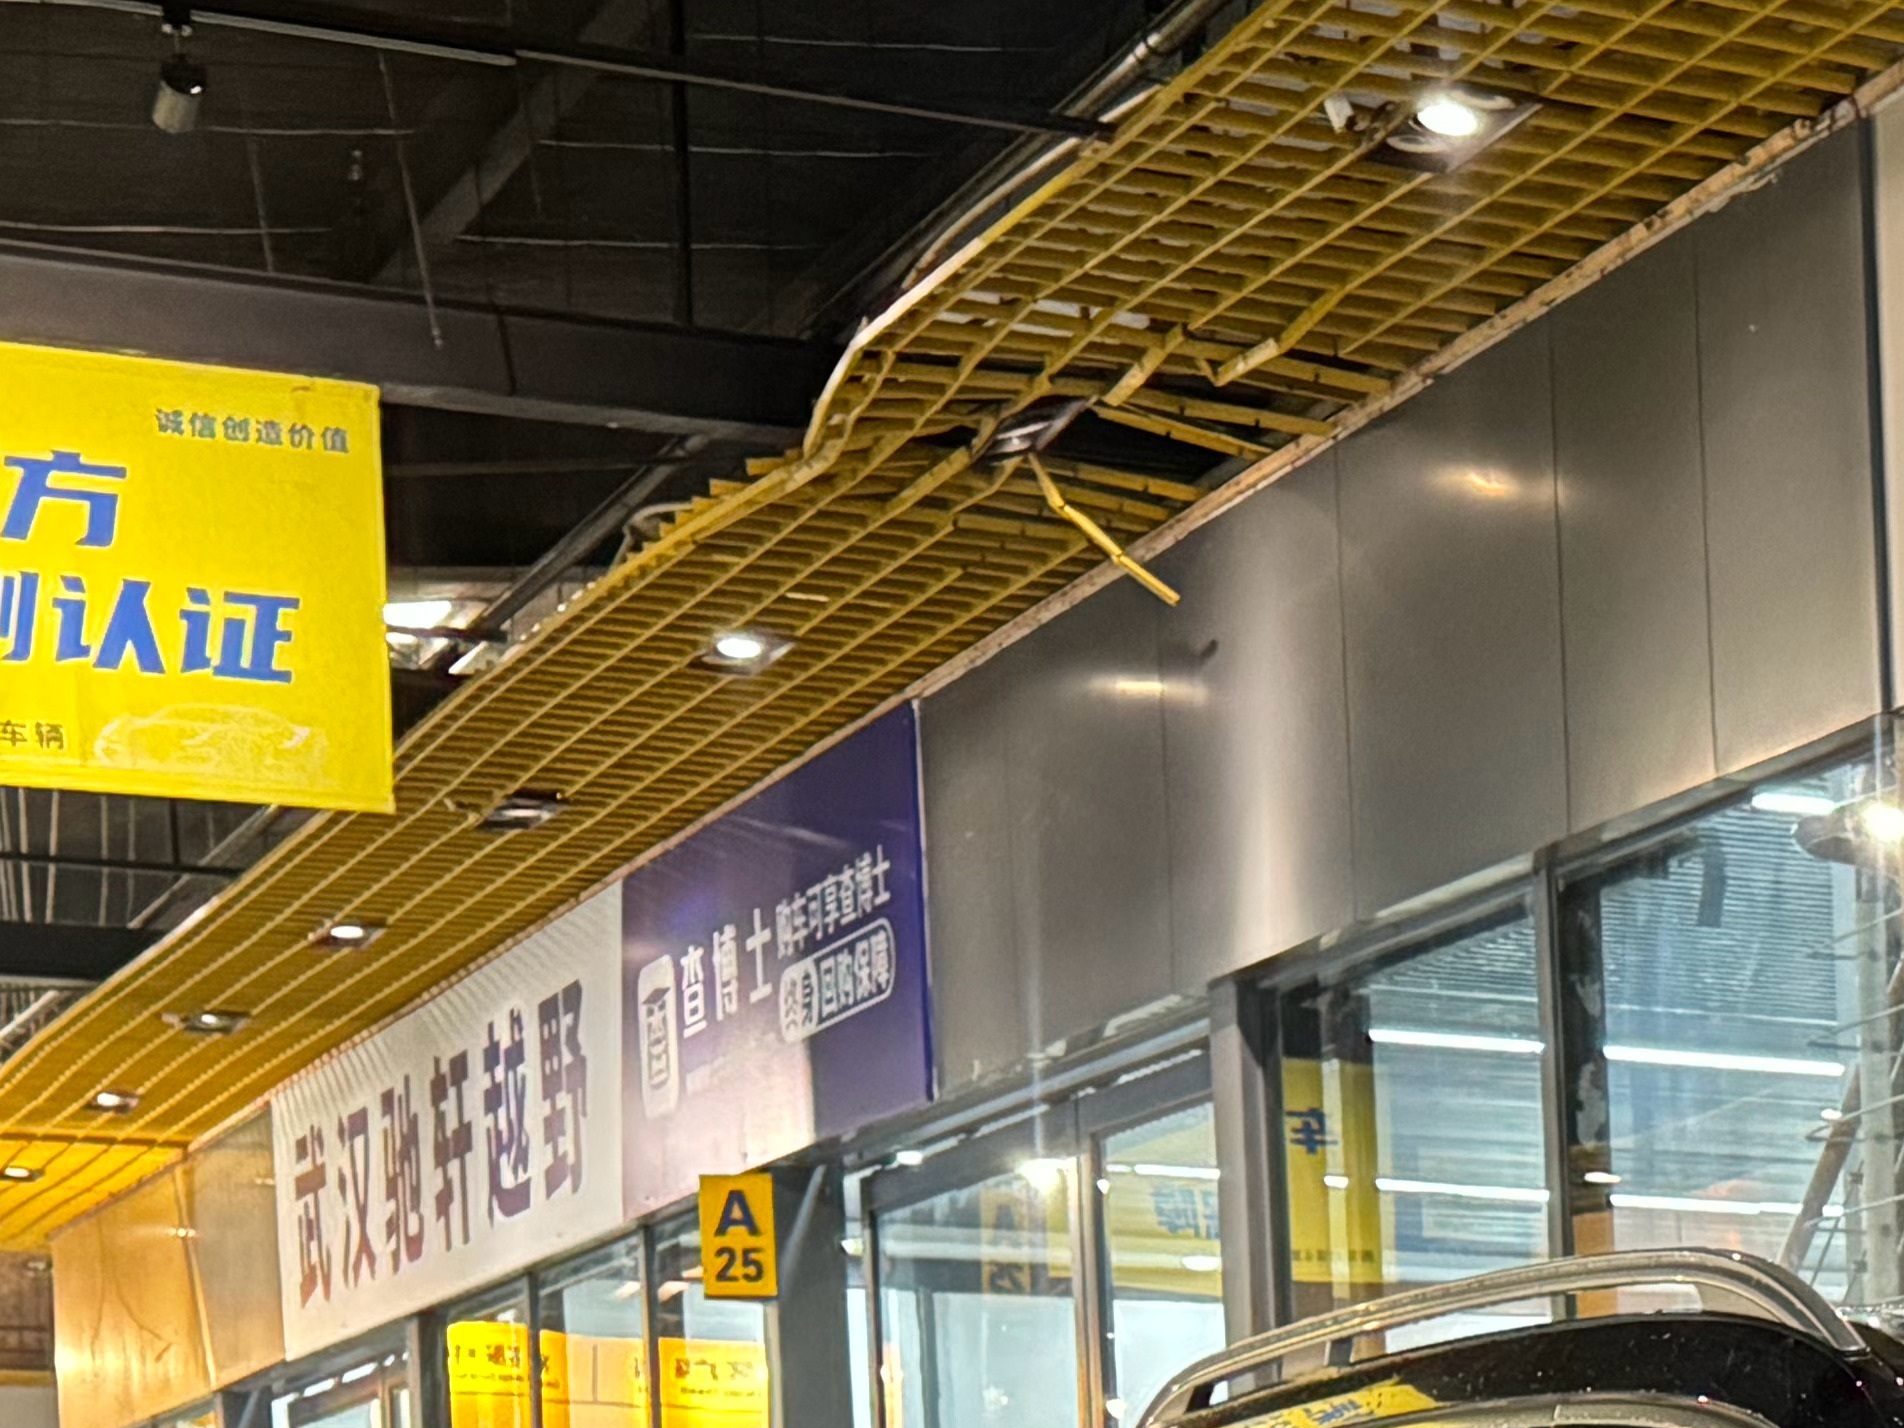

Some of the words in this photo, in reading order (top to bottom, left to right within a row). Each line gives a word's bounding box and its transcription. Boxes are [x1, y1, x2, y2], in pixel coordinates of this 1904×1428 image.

[154, 407, 350, 454] 诚信创造价值
[2, 449, 128, 548] 方
[0, 718, 65, 750] 车辆
[680, 908, 773, 1039] 查博士
[294, 978, 588, 1310] 武汉驰轩越野
[714, 1189, 762, 1237] A
[714, 1246, 764, 1283] 25
